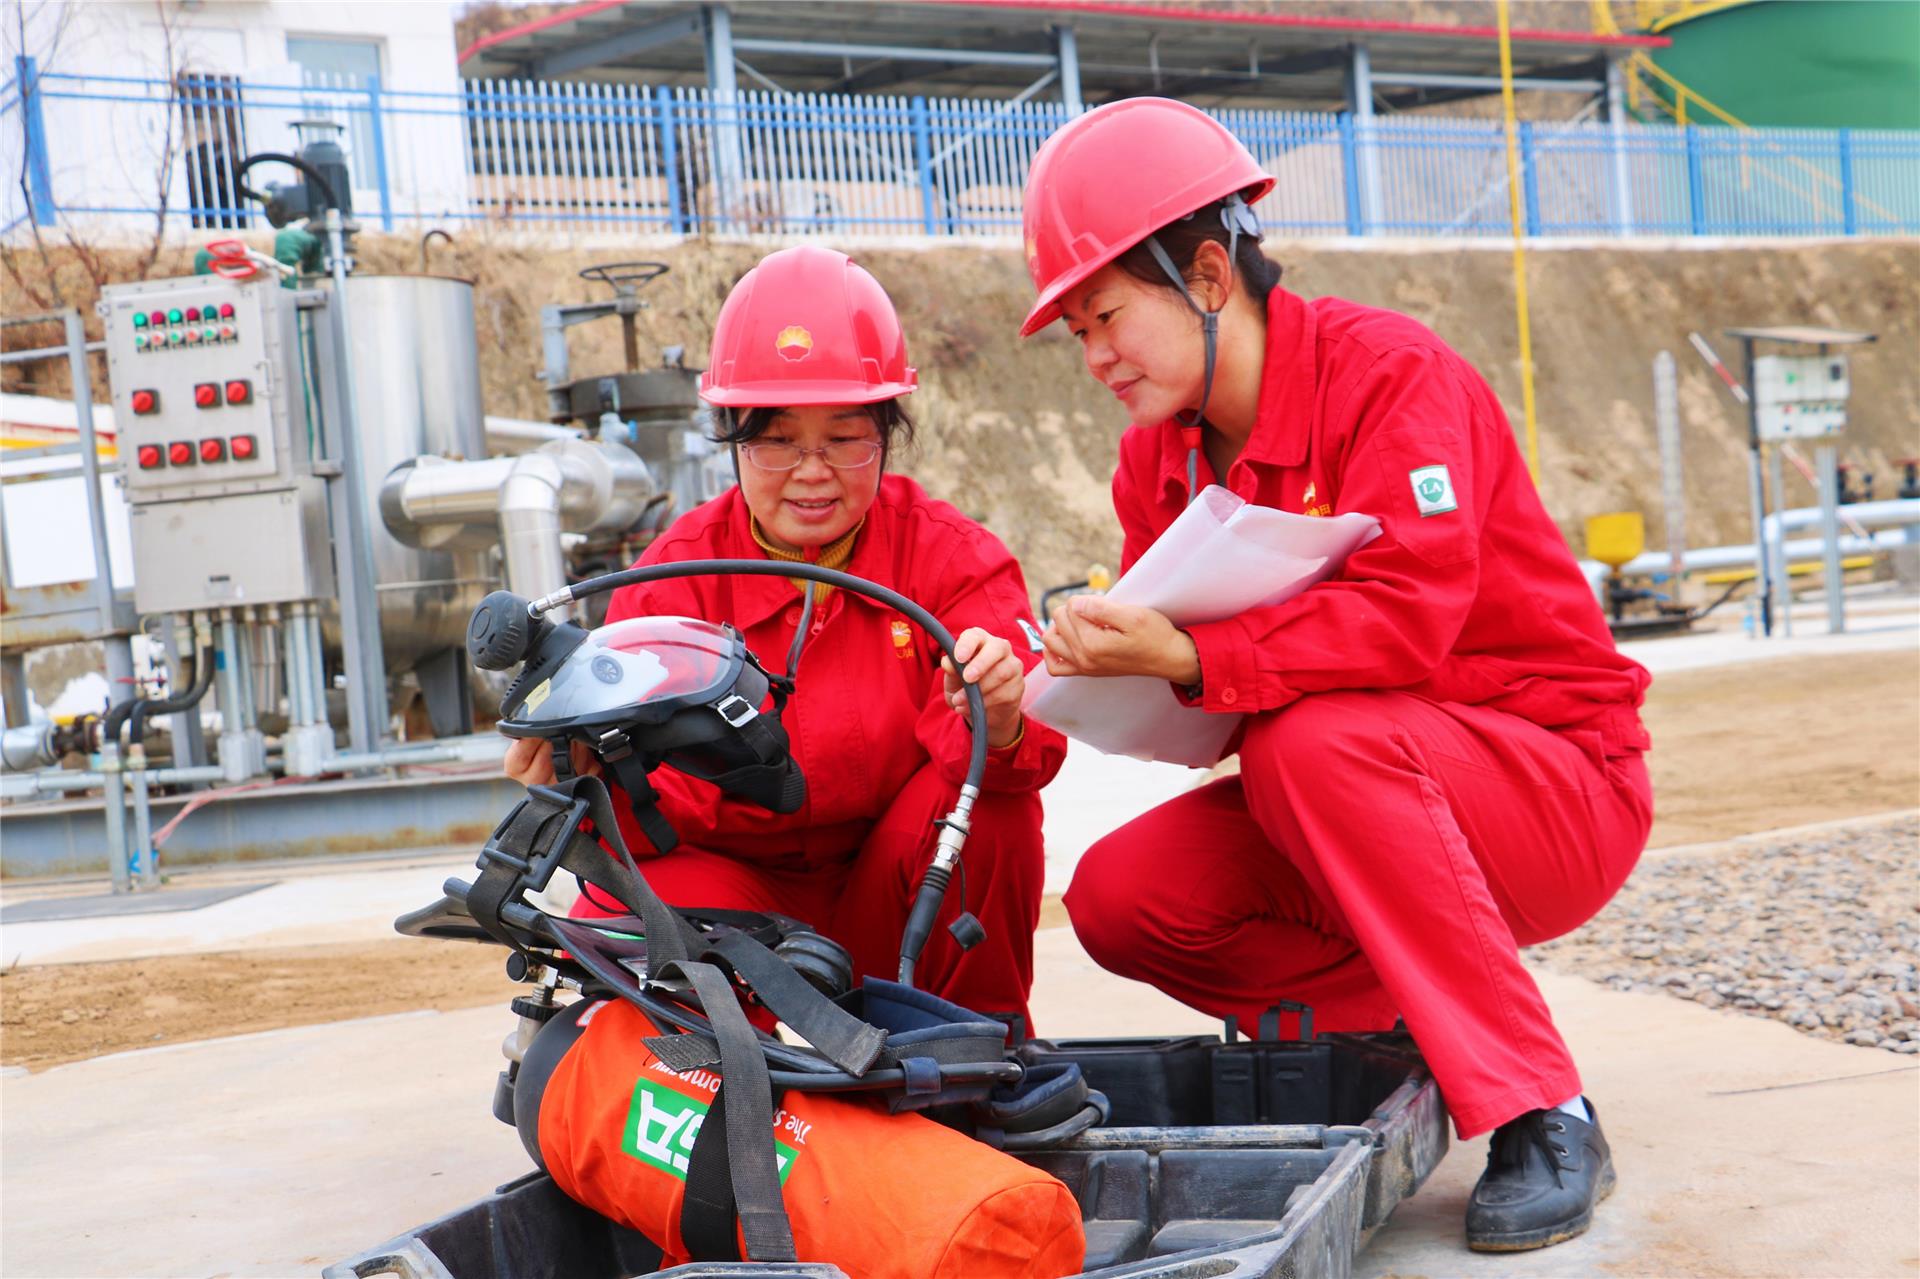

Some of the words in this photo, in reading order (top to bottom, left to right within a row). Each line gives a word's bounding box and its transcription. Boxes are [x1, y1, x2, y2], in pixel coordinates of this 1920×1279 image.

[1422, 481, 1443, 496] LA
[650, 1060, 722, 1093] ompy
[785, 1115, 812, 1145] The
